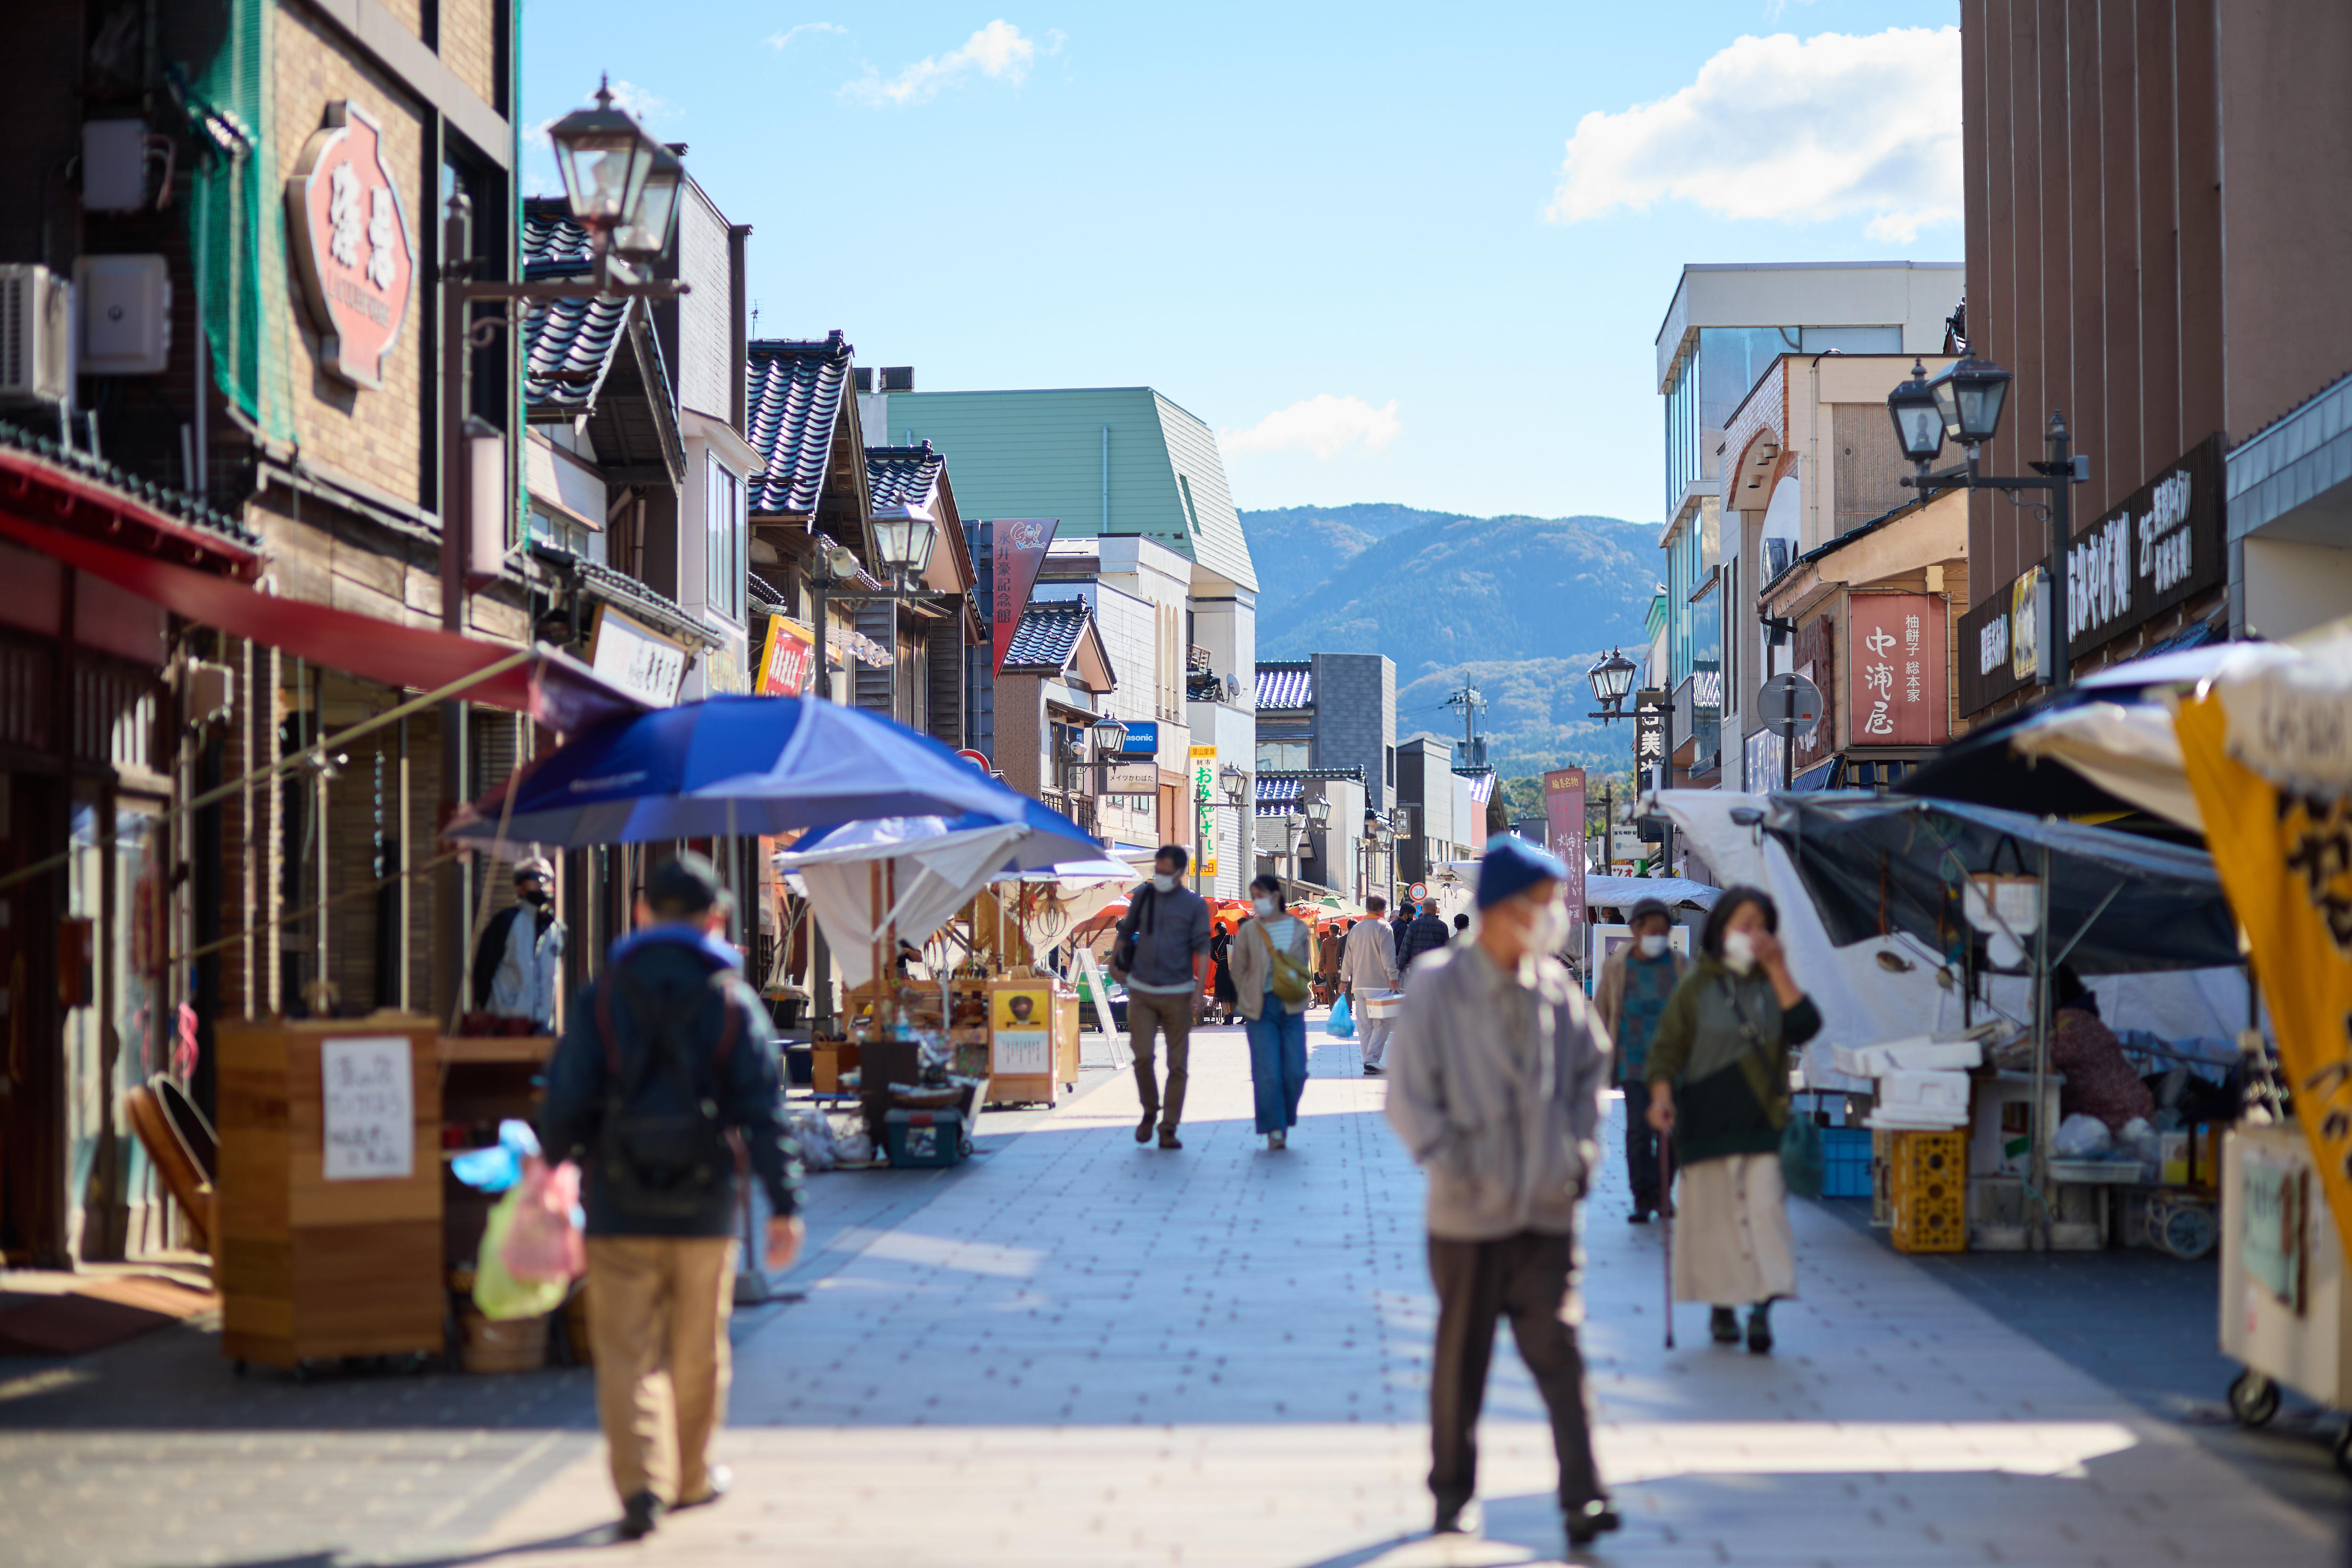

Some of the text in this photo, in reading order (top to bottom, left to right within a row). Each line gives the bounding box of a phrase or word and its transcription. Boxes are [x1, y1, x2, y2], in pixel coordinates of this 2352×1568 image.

[997, 531, 1011, 623] 永井豪記念館
[1906, 615, 1920, 702] 柚餅子 総本家
[1864, 626, 1896, 734] 中浦屋
[1552, 777, 1579, 789] 輪島名物
[1193, 863, 1214, 872] 田
[1611, 867, 1633, 877] ツオ
[1414, 888, 1424, 896] 30
